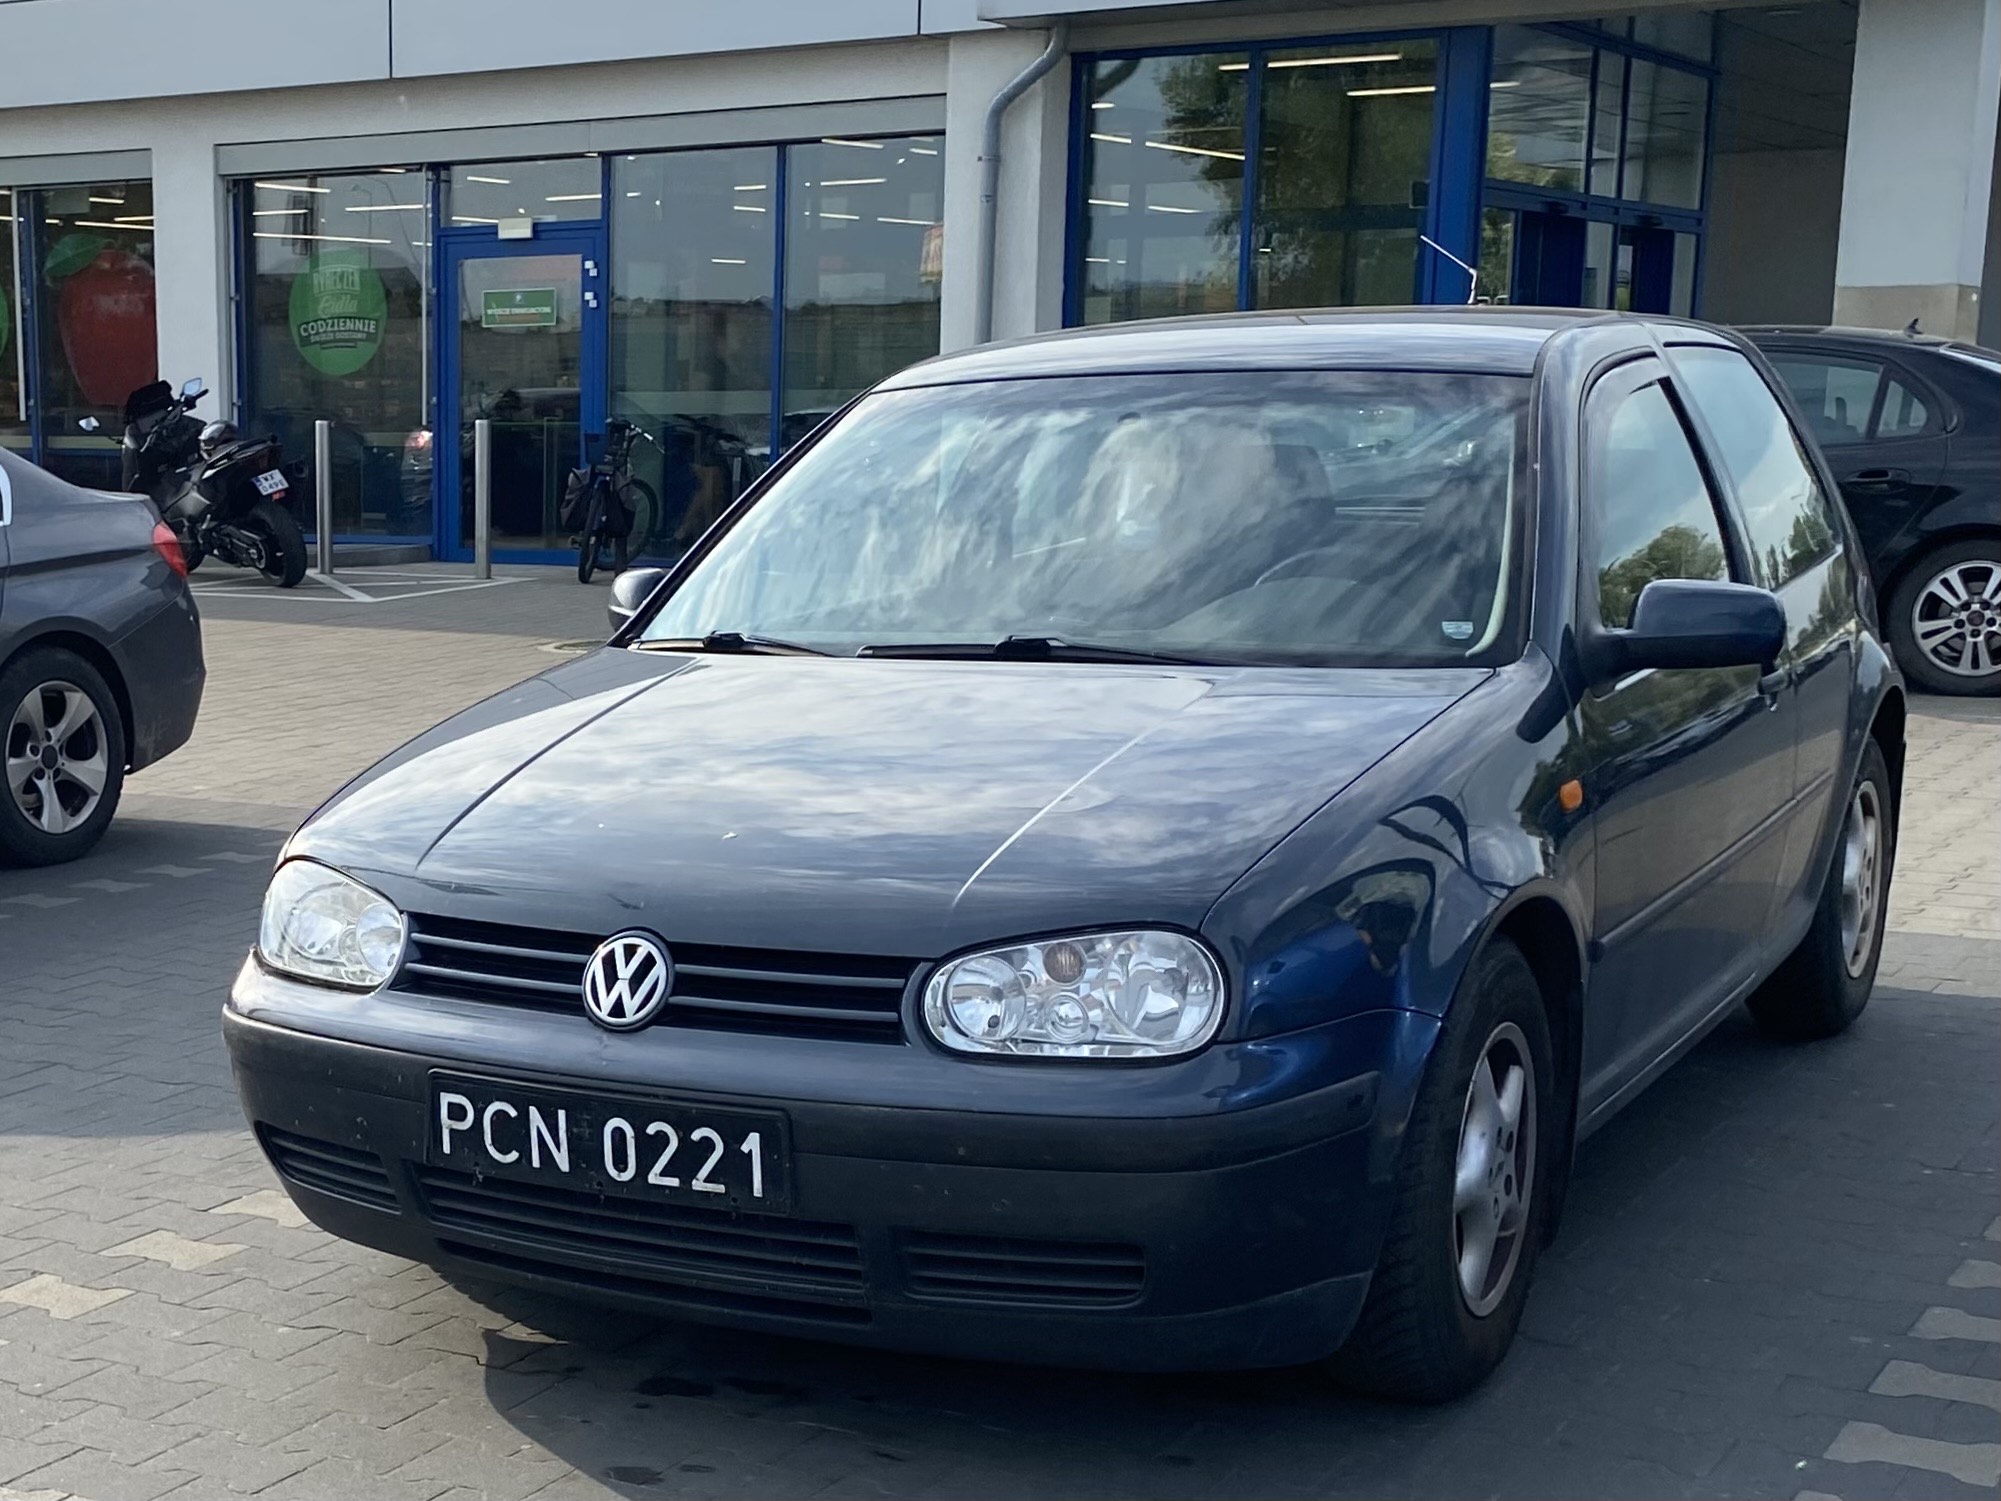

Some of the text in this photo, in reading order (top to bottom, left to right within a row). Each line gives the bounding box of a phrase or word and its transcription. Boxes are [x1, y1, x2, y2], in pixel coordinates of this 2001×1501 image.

[300, 318, 377, 337] CODZIENNIE
[439, 1091, 764, 1198] PCN 0221
